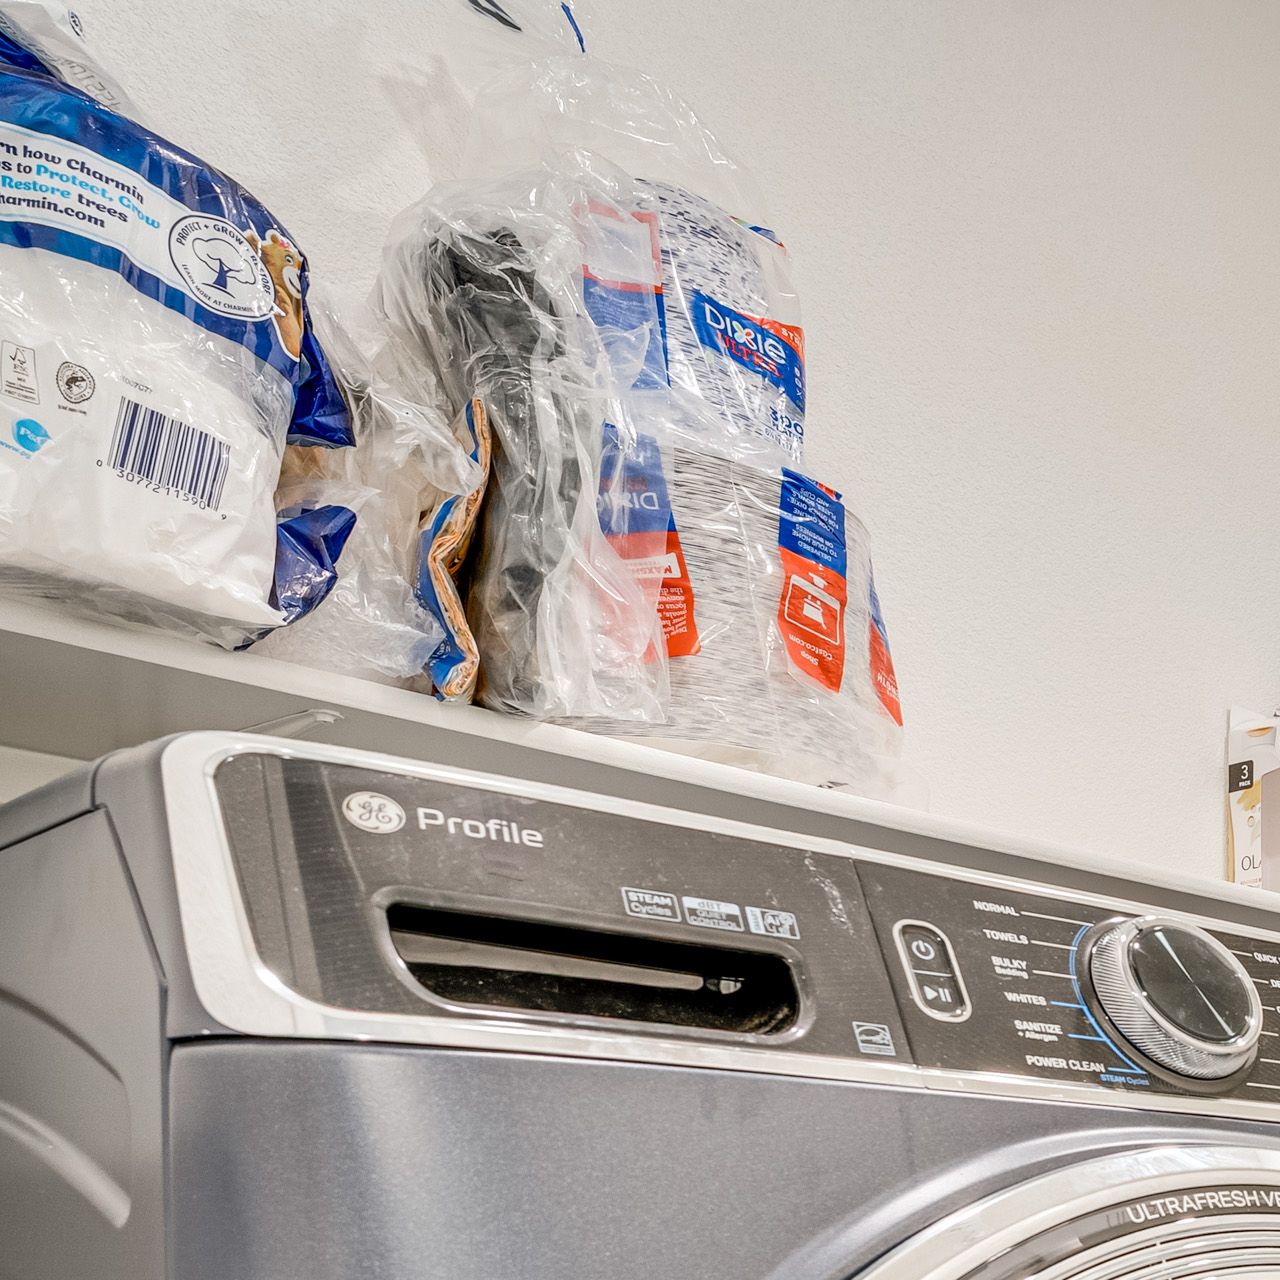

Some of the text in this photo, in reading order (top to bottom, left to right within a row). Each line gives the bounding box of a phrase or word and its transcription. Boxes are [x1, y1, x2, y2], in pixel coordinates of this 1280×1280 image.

[23, 145, 62, 165] how
[66, 158, 145, 205] Charmin
[1, 174, 129, 223] Restore trees
[17, 162, 161, 229] to Protect, Grow
[176, 222, 271, 295] PROTECT GROW RETORE
[195, 285, 211, 301] MORE
[770, 406, 804, 437] 300
[789, 634, 832, 660] Costco.com
[1240, 765, 1249, 780] 3
[417, 806, 544, 848] Profile
[628, 892, 672, 906] STEAM
[630, 902, 672, 916] Cycles
[696, 909, 728, 920] QUIET
[972, 900, 1020, 917] NORMAL
[689, 915, 737, 929] CONTROL
[983, 929, 1028, 945] TOWELS
[991, 956, 1028, 970] BULKY
[1253, 952, 1279, 966] QUICK
[995, 966, 1029, 980] Bedding
[1004, 991, 1047, 1006] WHITES
[1014, 1019, 1063, 1035] SANITIZE
[1025, 1031, 1059, 1042] Allergen
[1025, 1054, 1106, 1073] POWER CLEAN
[1100, 1073, 1126, 1084] STEAM
[1126, 1190, 1261, 1224] ULTRAFRESH
